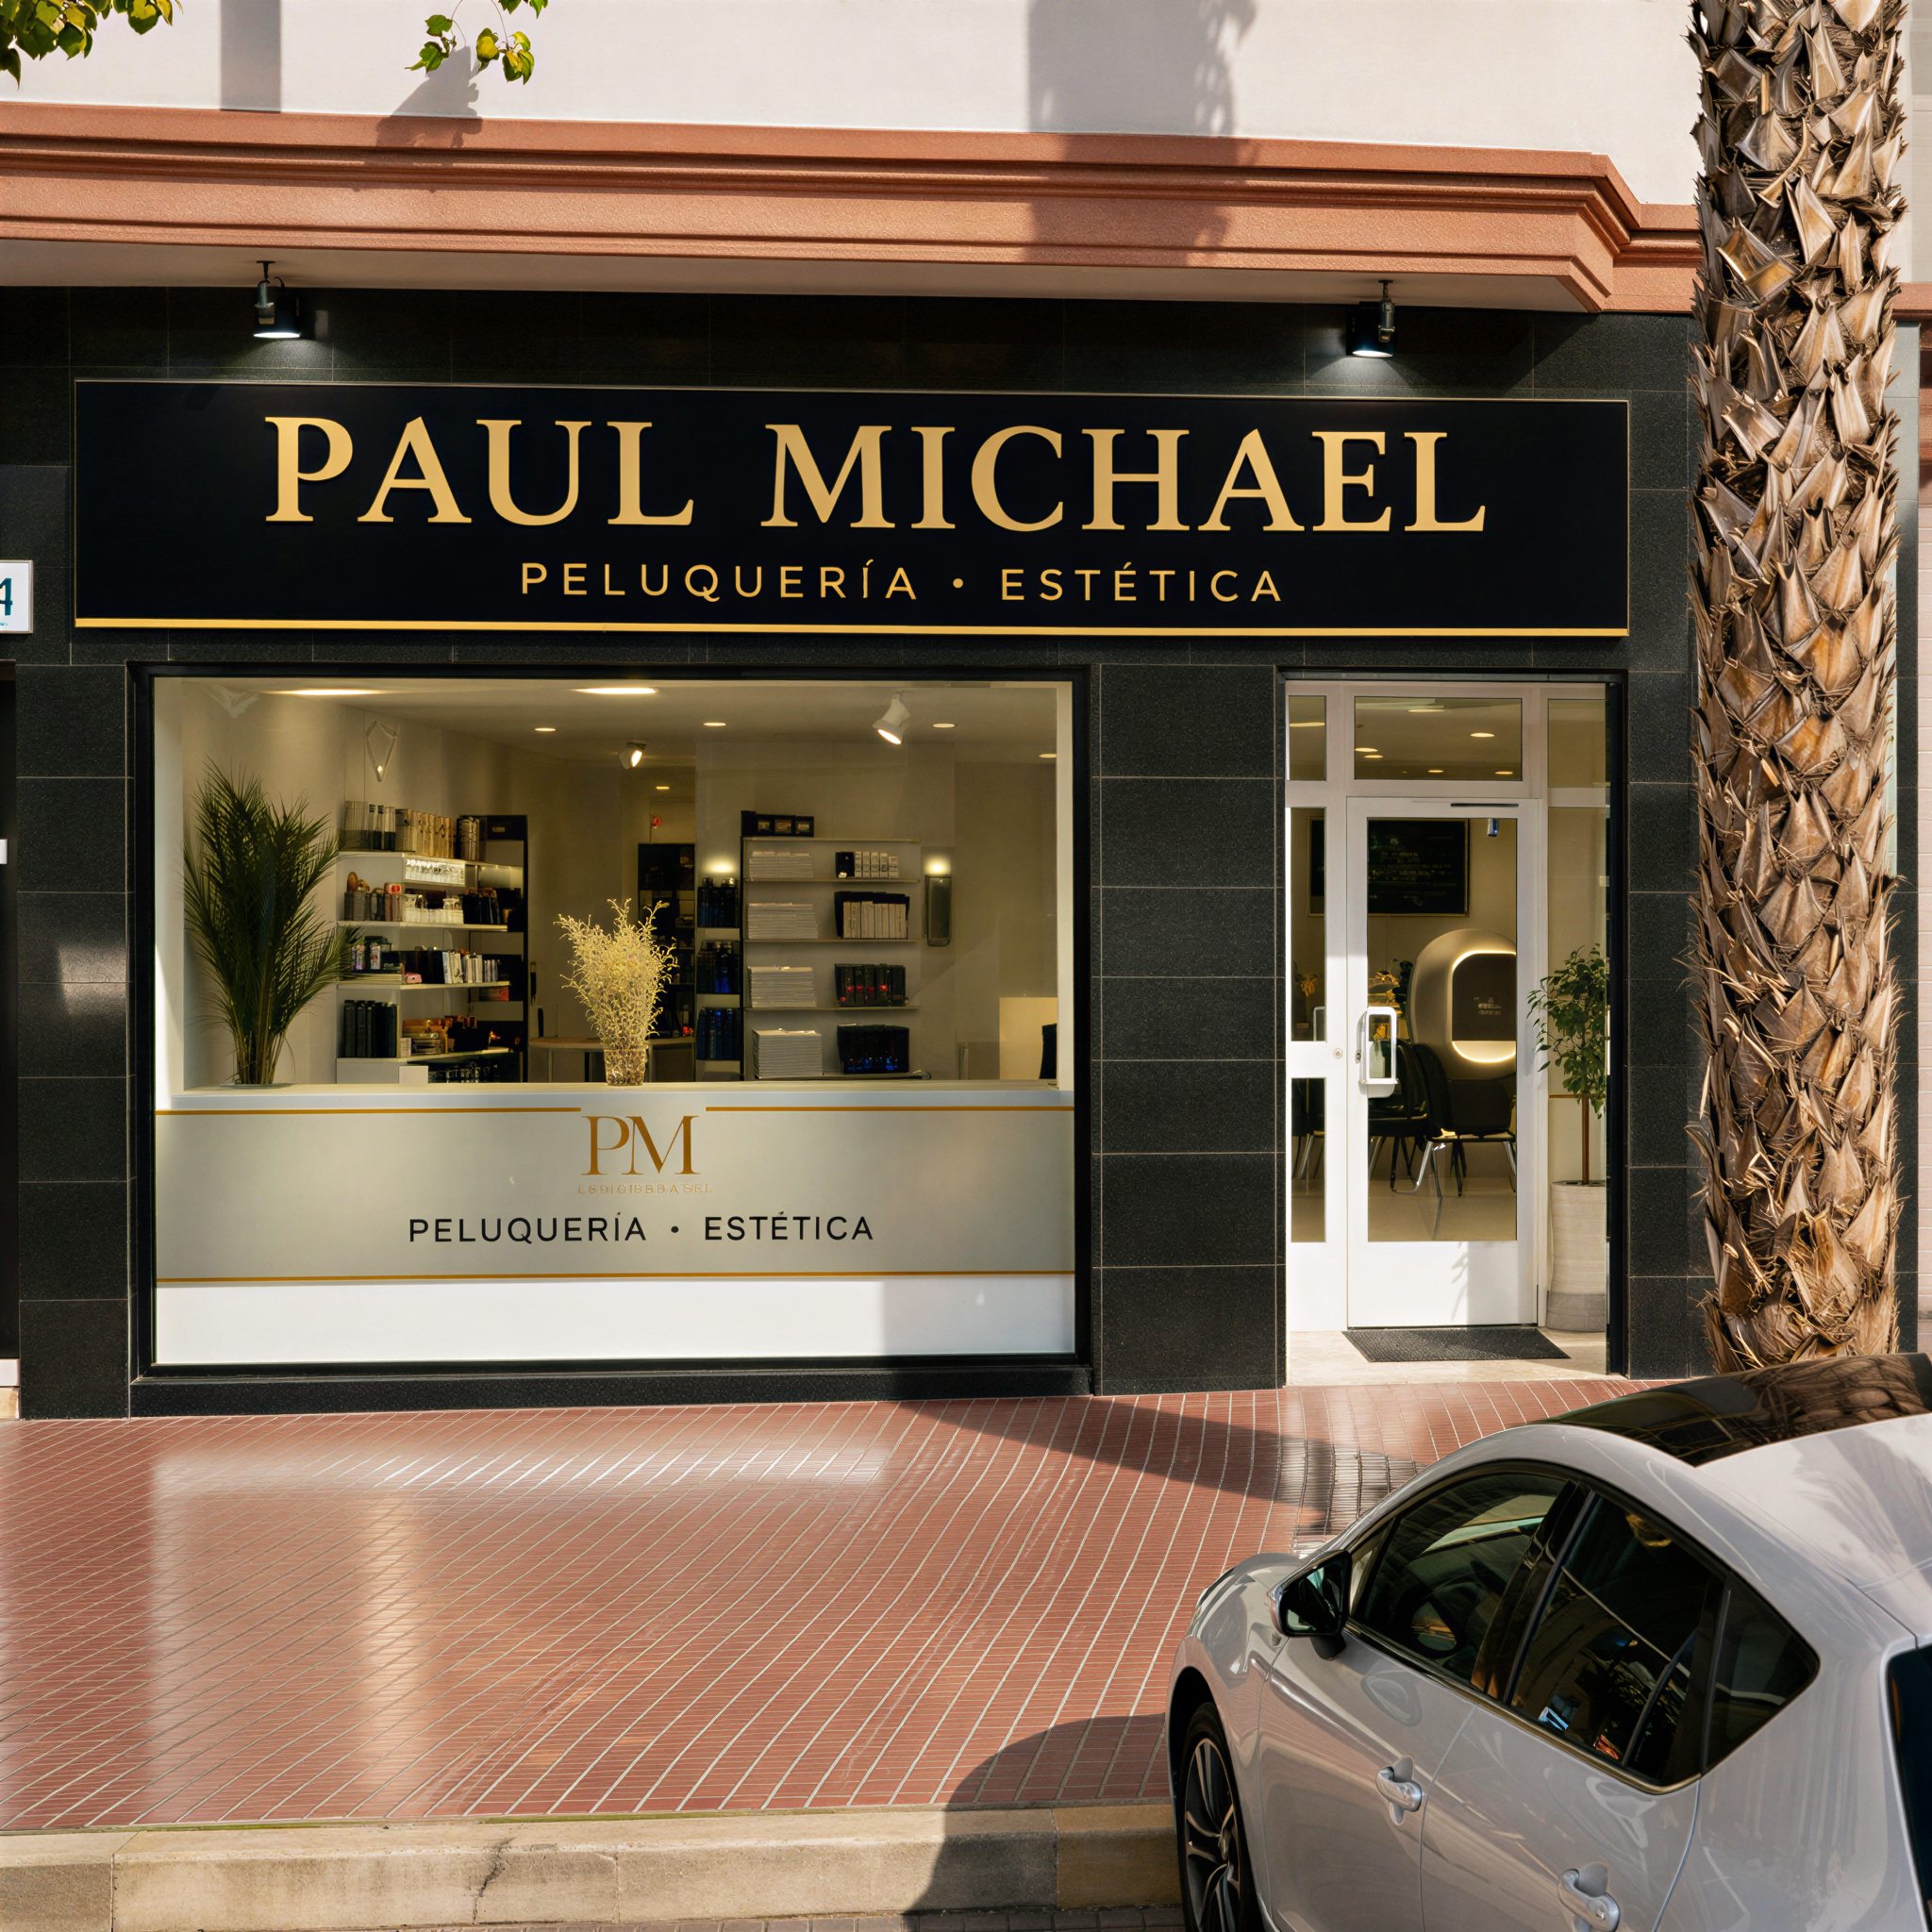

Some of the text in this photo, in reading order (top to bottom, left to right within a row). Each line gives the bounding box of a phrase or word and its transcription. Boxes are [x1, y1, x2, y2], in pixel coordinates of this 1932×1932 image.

[265, 417, 1487, 533] PAUL MICHAEL
[520, 559, 918, 603] PELUQUERÍA
[1000, 562, 1282, 603] ESTÉTICA
[580, 1115, 702, 1175] PM
[409, 1212, 646, 1244] PELUQUERÍA
[705, 1211, 874, 1241] ESTÉTICA
